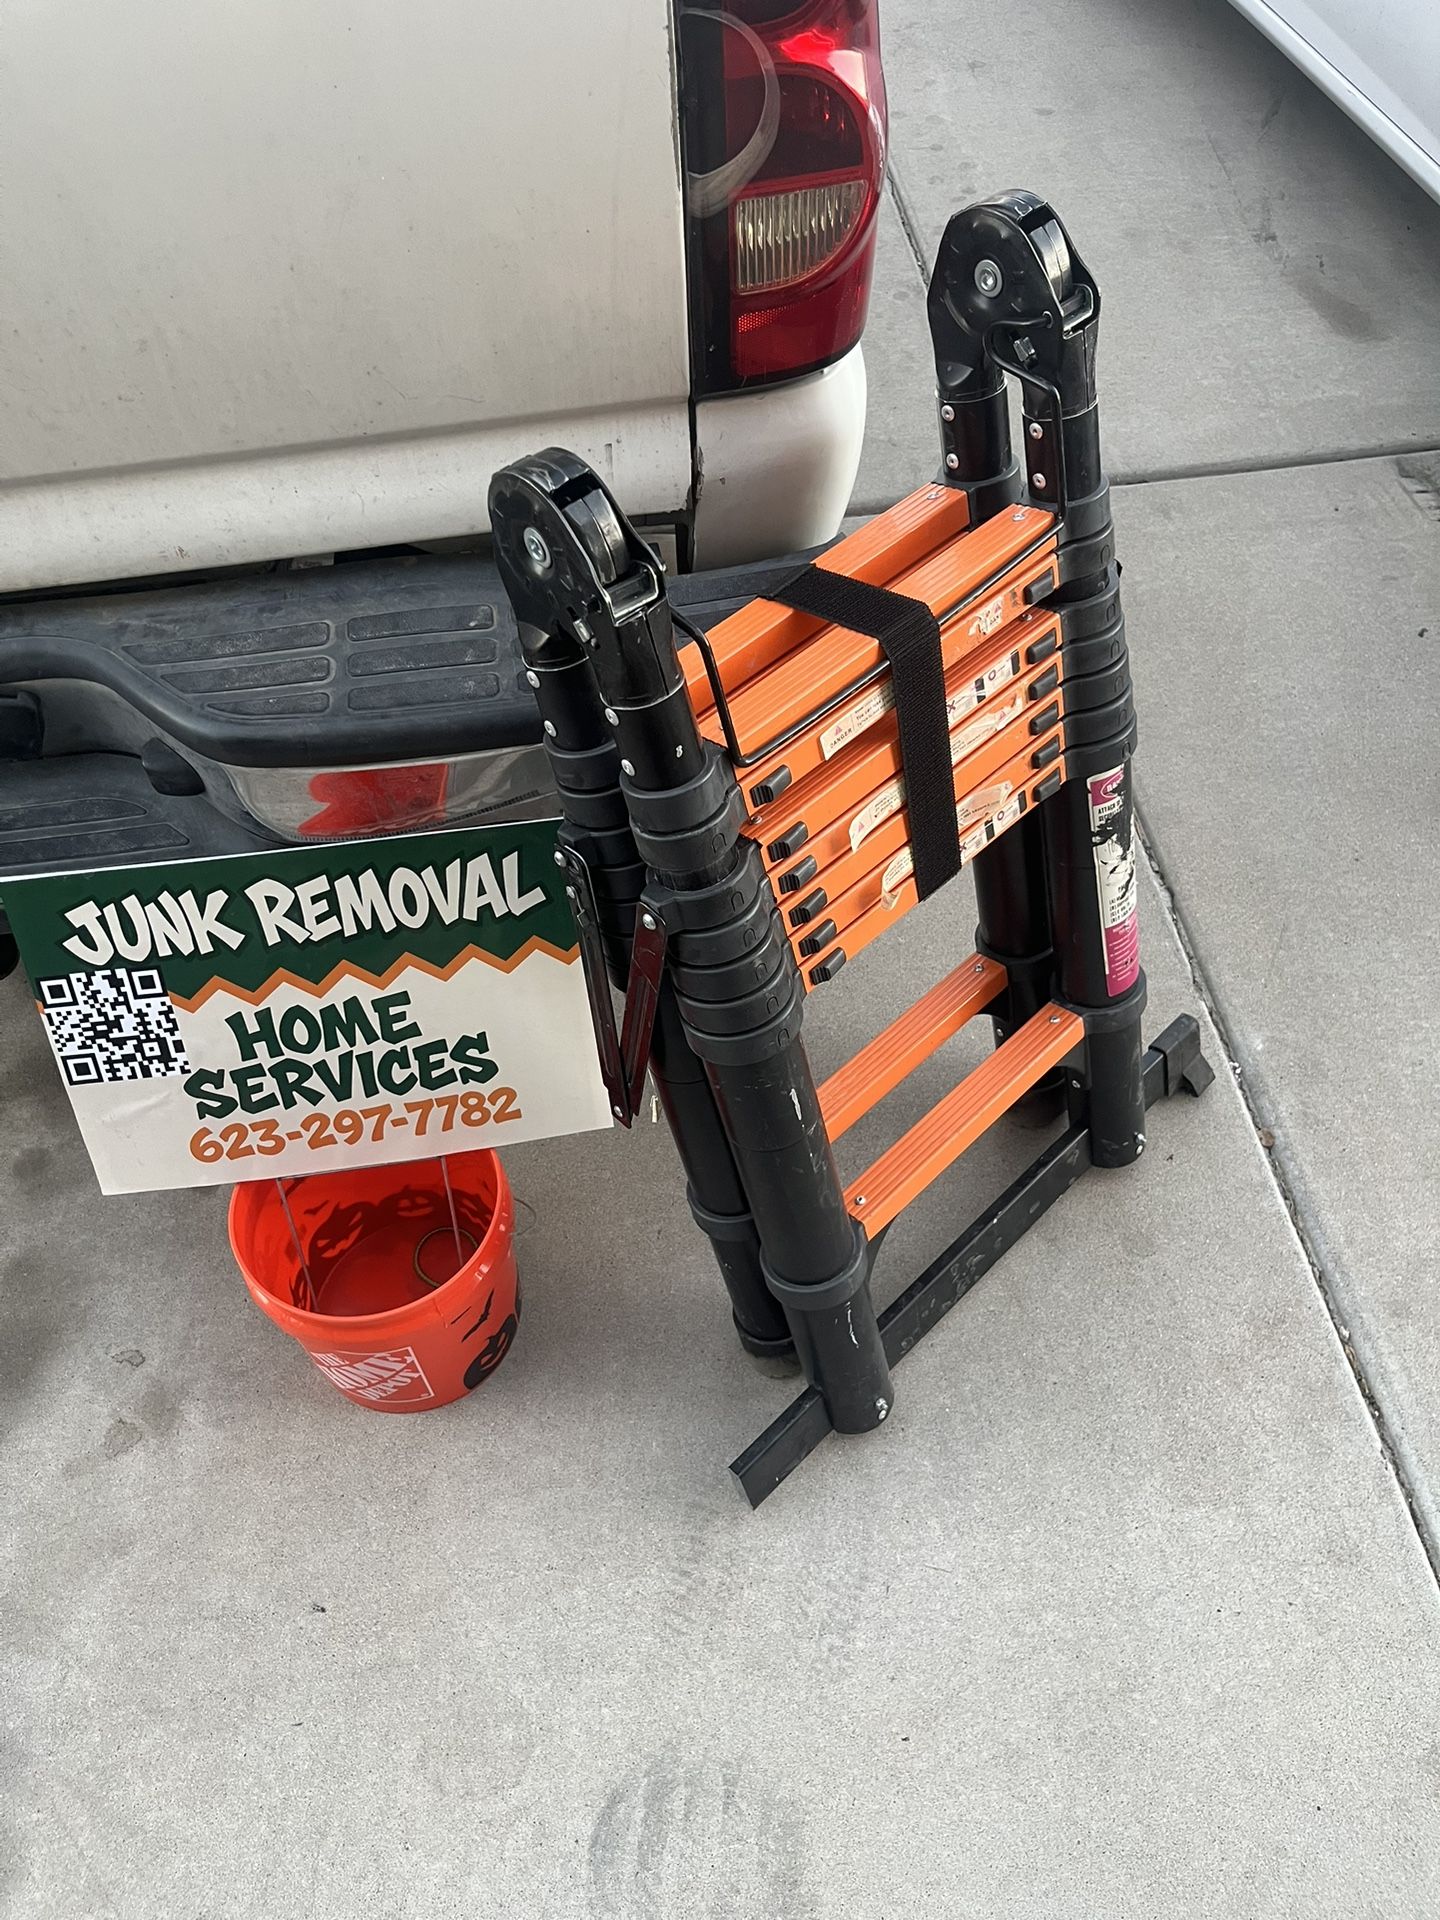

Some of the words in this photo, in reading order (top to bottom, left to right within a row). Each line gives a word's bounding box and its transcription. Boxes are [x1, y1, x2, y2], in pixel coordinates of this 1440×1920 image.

[62, 889, 245, 965] JUNK
[245, 851, 545, 947] REMOVAL
[225, 991, 422, 1061] HOME
[183, 1031, 499, 1119] SERVICES
[189, 1087, 522, 1163] 623-297-7782
[357, 1369, 421, 1400] DEPOT
